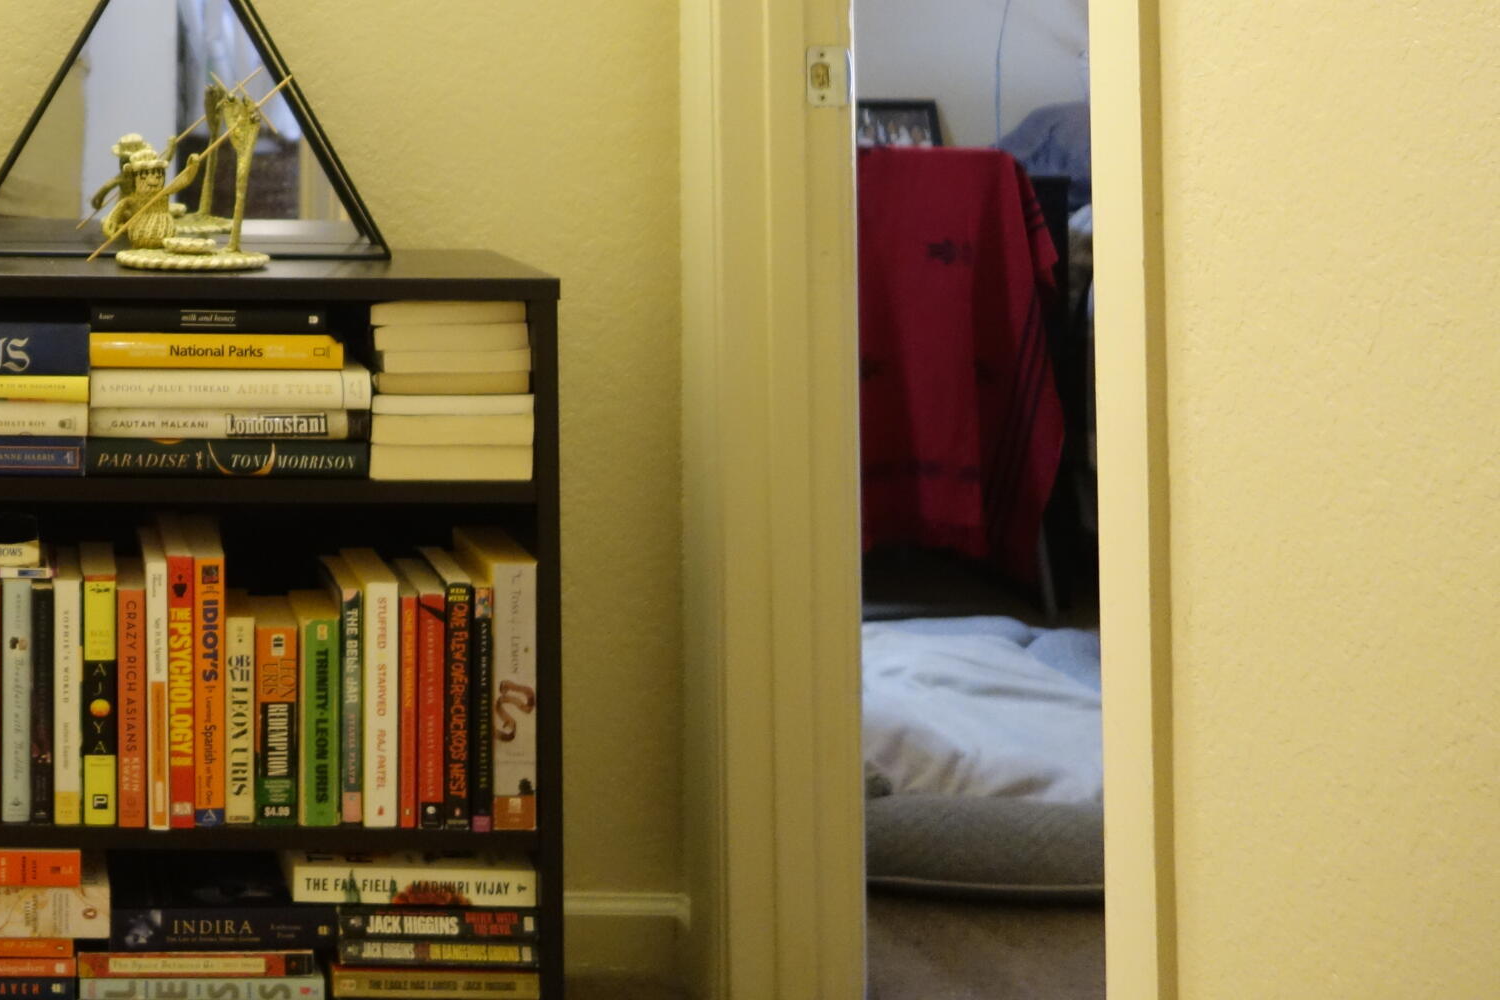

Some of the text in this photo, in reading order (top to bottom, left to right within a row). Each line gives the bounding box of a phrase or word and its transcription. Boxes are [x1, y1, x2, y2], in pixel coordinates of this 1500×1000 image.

[169, 344, 224, 357] National
[228, 345, 263, 357] Parks
[110, 420, 209, 430] GAUTAM MALKANI
[225, 412, 328, 436] Londonstani
[97, 452, 190, 469] PARADISE
[231, 453, 355, 470] TONI MORRISON
[450, 603, 469, 629] ONE
[202, 599, 220, 682] IDIOT'S
[345, 607, 359, 704] THE BELL JAR
[376, 596, 387, 717] STUFFED STARVED
[449, 630, 469, 661] FLEW
[125, 600, 137, 752] CRAZY RICH ASIANS
[169, 621, 194, 755] PSYCHOLOGY
[449, 662, 468, 695] OVER
[231, 687, 249, 741] LEON
[315, 648, 329, 804] TRINITY LEON URIS
[201, 724, 218, 765] Spanish
[267, 703, 289, 777] REDEMPTION
[231, 747, 248, 797] URIS
[376, 728, 387, 790] RAJ PATEL
[448, 763, 468, 799] NEST
[305, 877, 397, 893] THE FAR FIELD
[411, 880, 510, 895] MADHURI VIJAY
[172, 919, 253, 935] INDIRA
[366, 915, 459, 935] JACK HIGGINS
